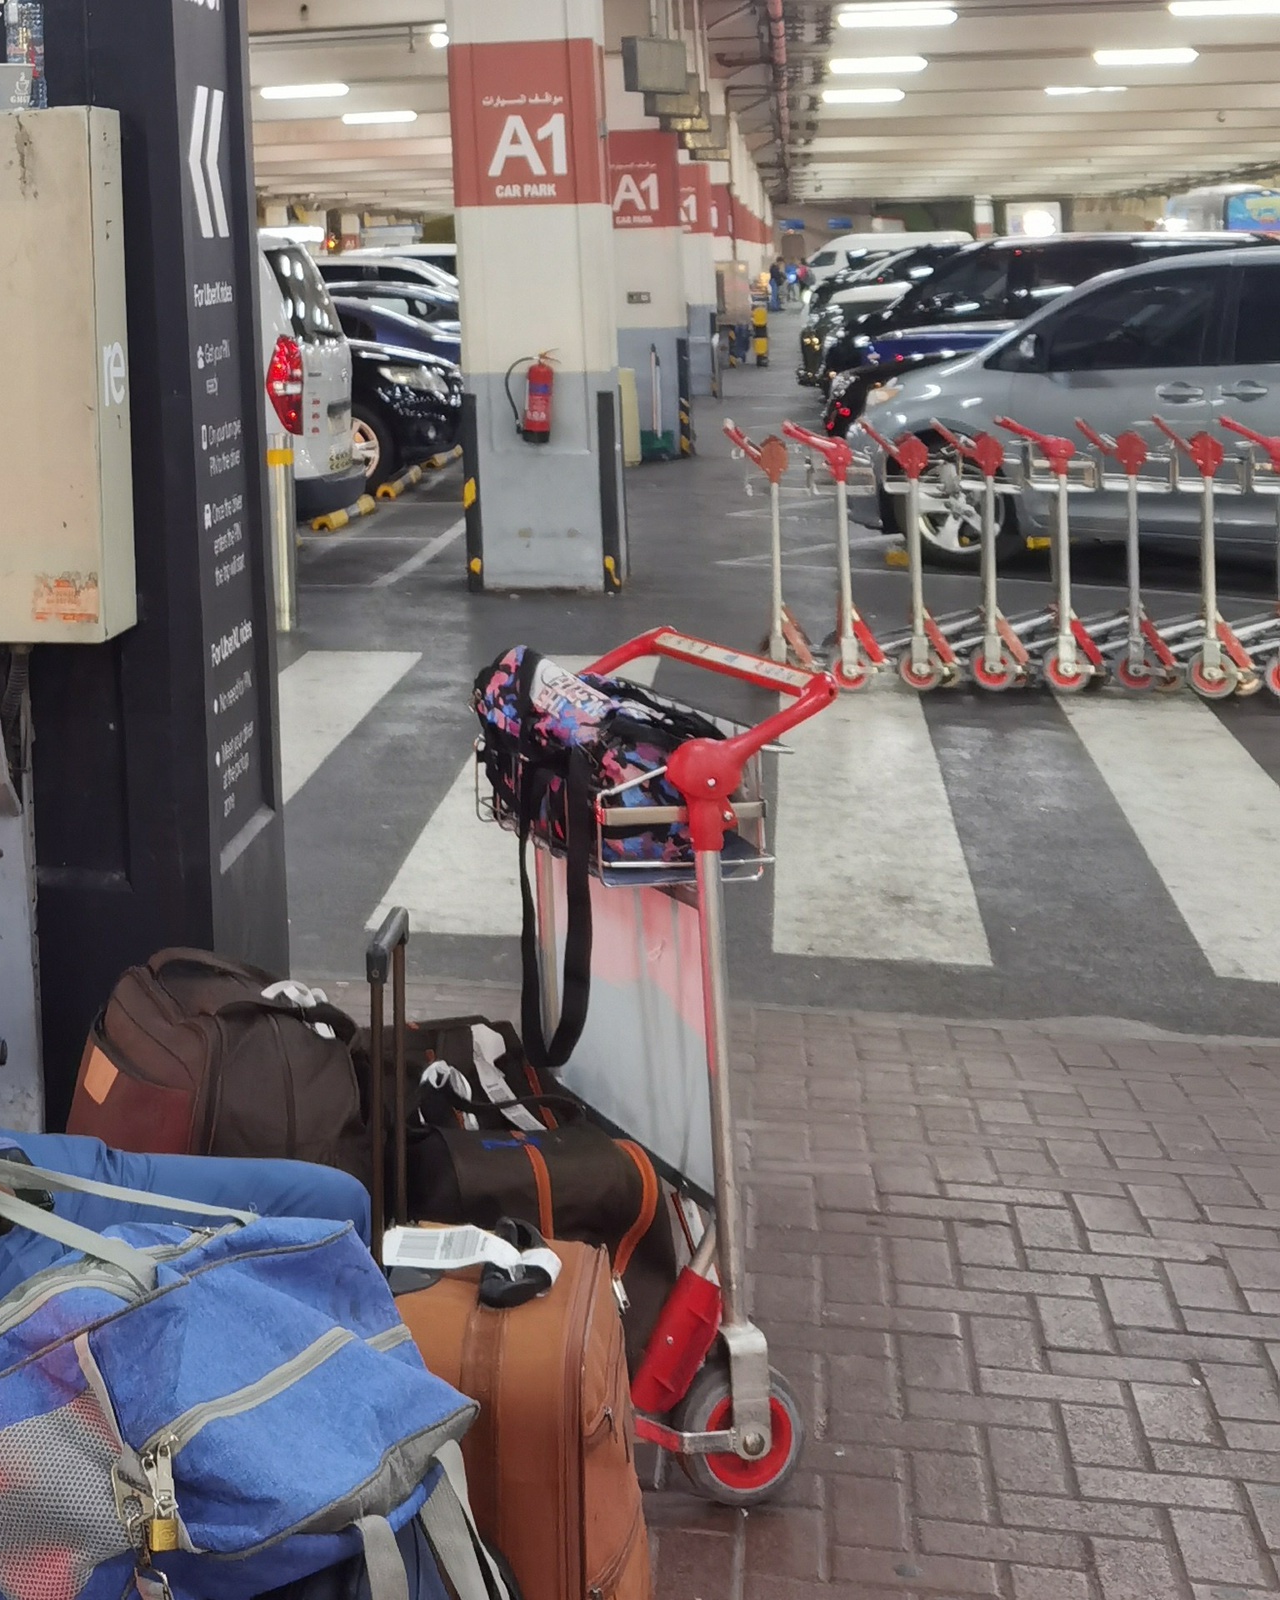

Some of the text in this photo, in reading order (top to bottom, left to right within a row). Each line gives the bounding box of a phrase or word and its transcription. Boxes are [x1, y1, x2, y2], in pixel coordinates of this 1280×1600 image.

[488, 112, 568, 177] A1
[495, 183, 557, 199] CAR PARK
[613, 172, 659, 212] A1
[103, 341, 125, 407] re
